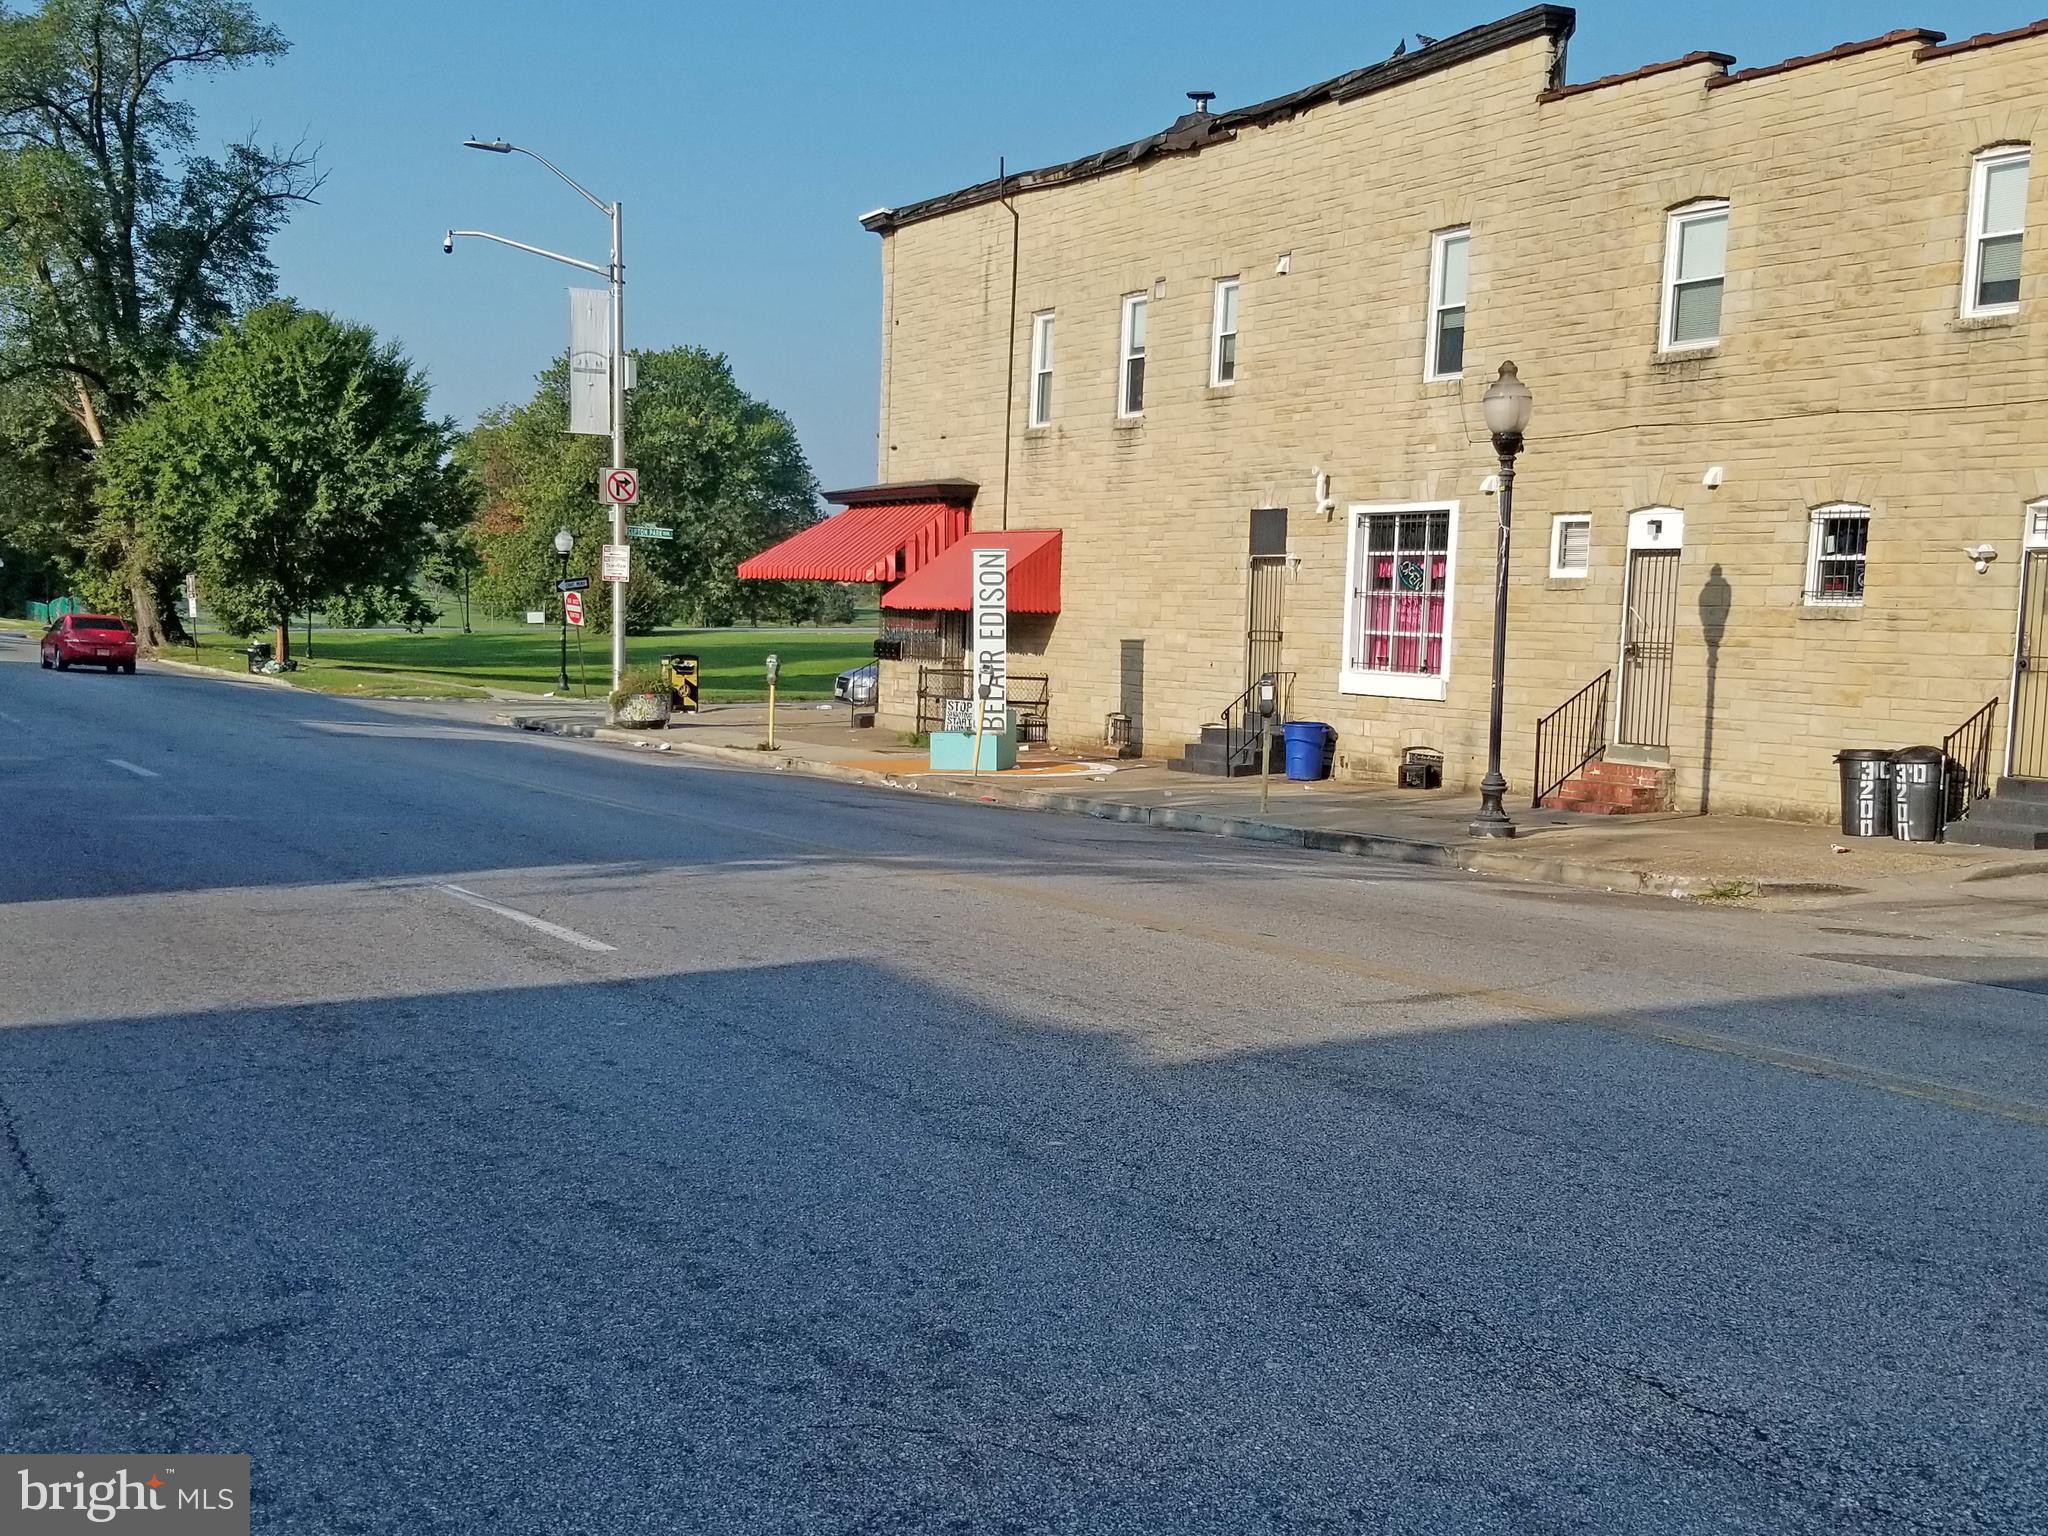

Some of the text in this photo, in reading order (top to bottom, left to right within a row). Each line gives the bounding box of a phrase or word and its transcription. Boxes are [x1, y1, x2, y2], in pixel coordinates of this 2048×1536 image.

[1400, 561, 1423, 589] OPEN
[979, 554, 1005, 640] EDISON
[947, 700, 972, 712] STOP
[947, 717, 972, 726] START
